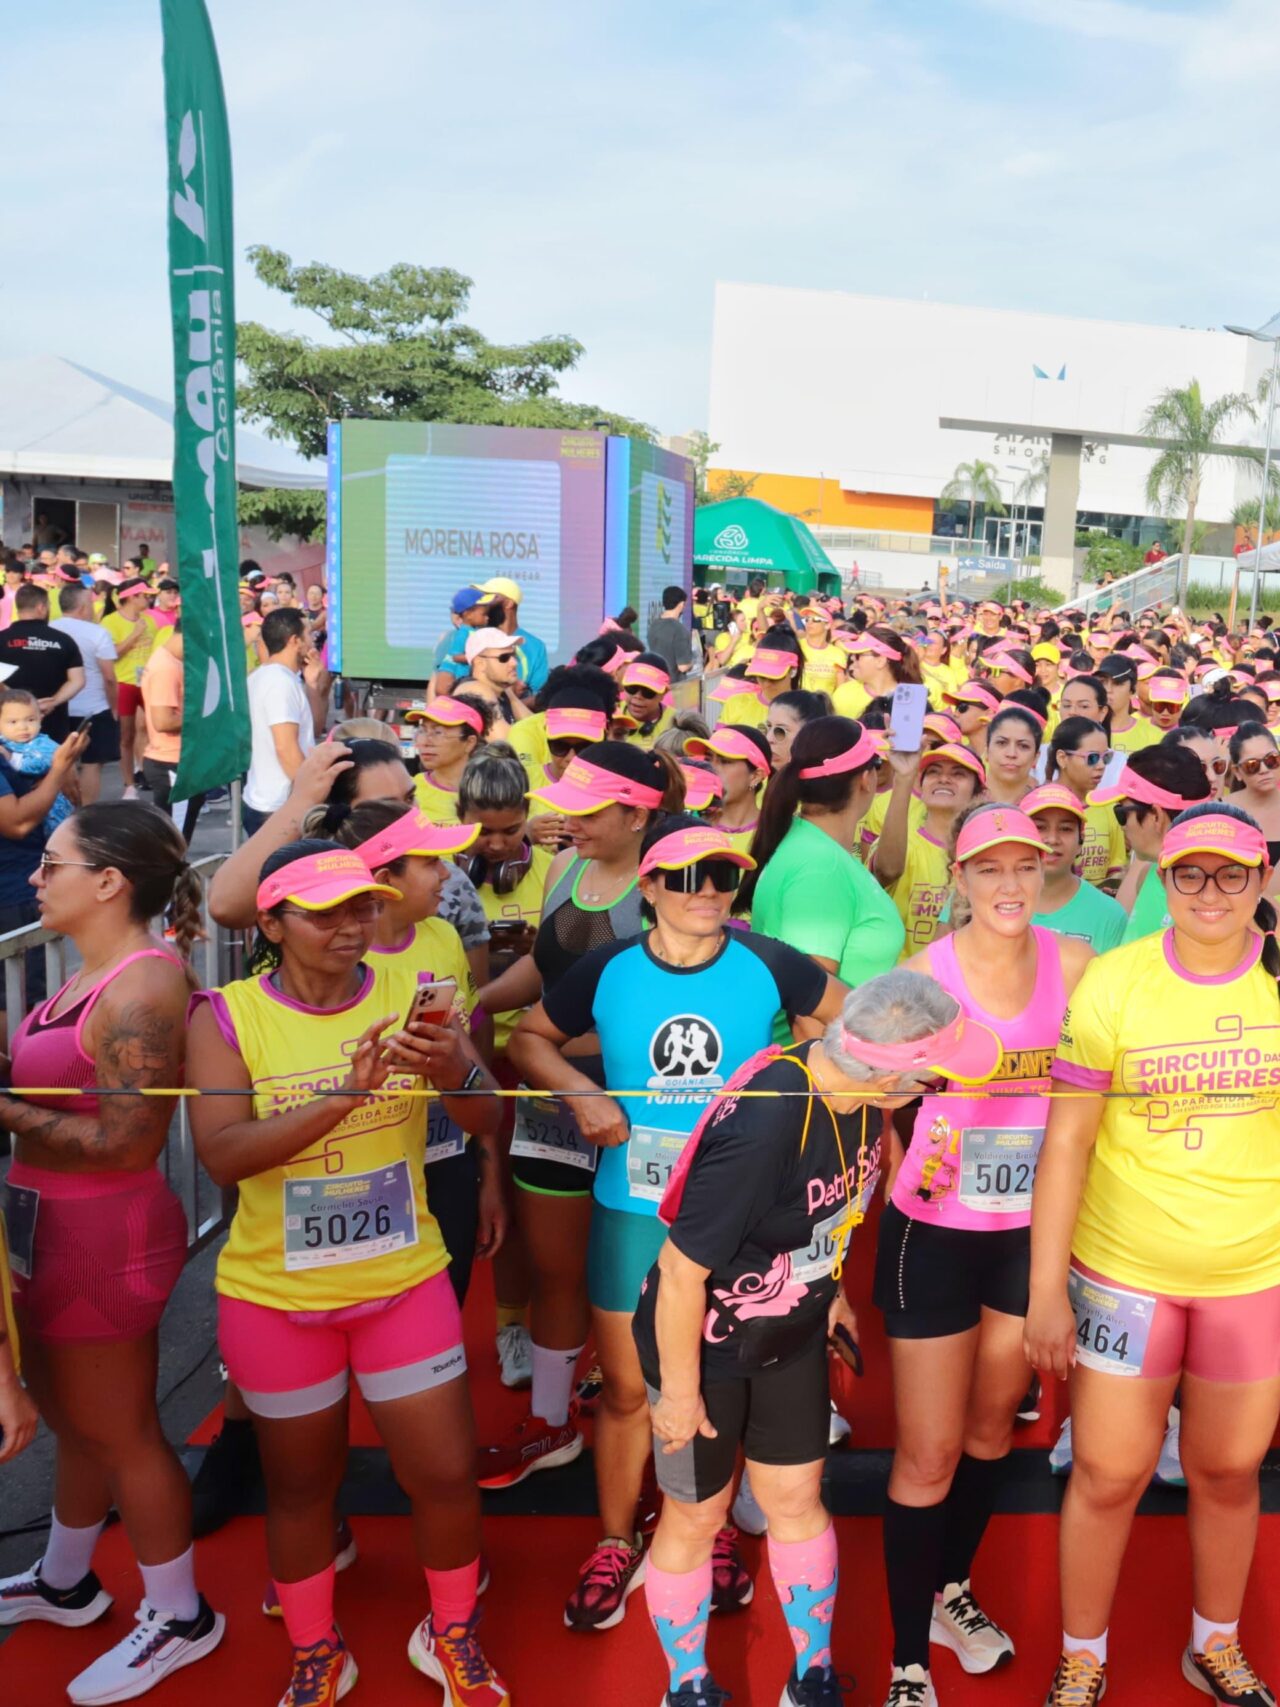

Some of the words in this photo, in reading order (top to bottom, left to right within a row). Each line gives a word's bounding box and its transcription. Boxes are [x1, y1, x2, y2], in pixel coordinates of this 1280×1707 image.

[211, 288, 230, 462] Goiânia
[994, 444, 1106, 465] SHOPNG
[404, 527, 485, 556] MORENA
[489, 531, 540, 560] ROSA
[693, 553, 740, 564] PARECIDA
[1081, 846, 1104, 856] UITO
[1138, 1048, 1261, 1078] CIRCUITO
[272, 1073, 352, 1106] CIRCU
[665, 1078, 705, 1087] GOIÂNIA
[526, 1118, 579, 1151] 5234
[648, 1161, 675, 1185] 51
[976, 1163, 1037, 1194] 502
[304, 1204, 391, 1248] 5026
[1073, 1306, 1129, 1360] 464
